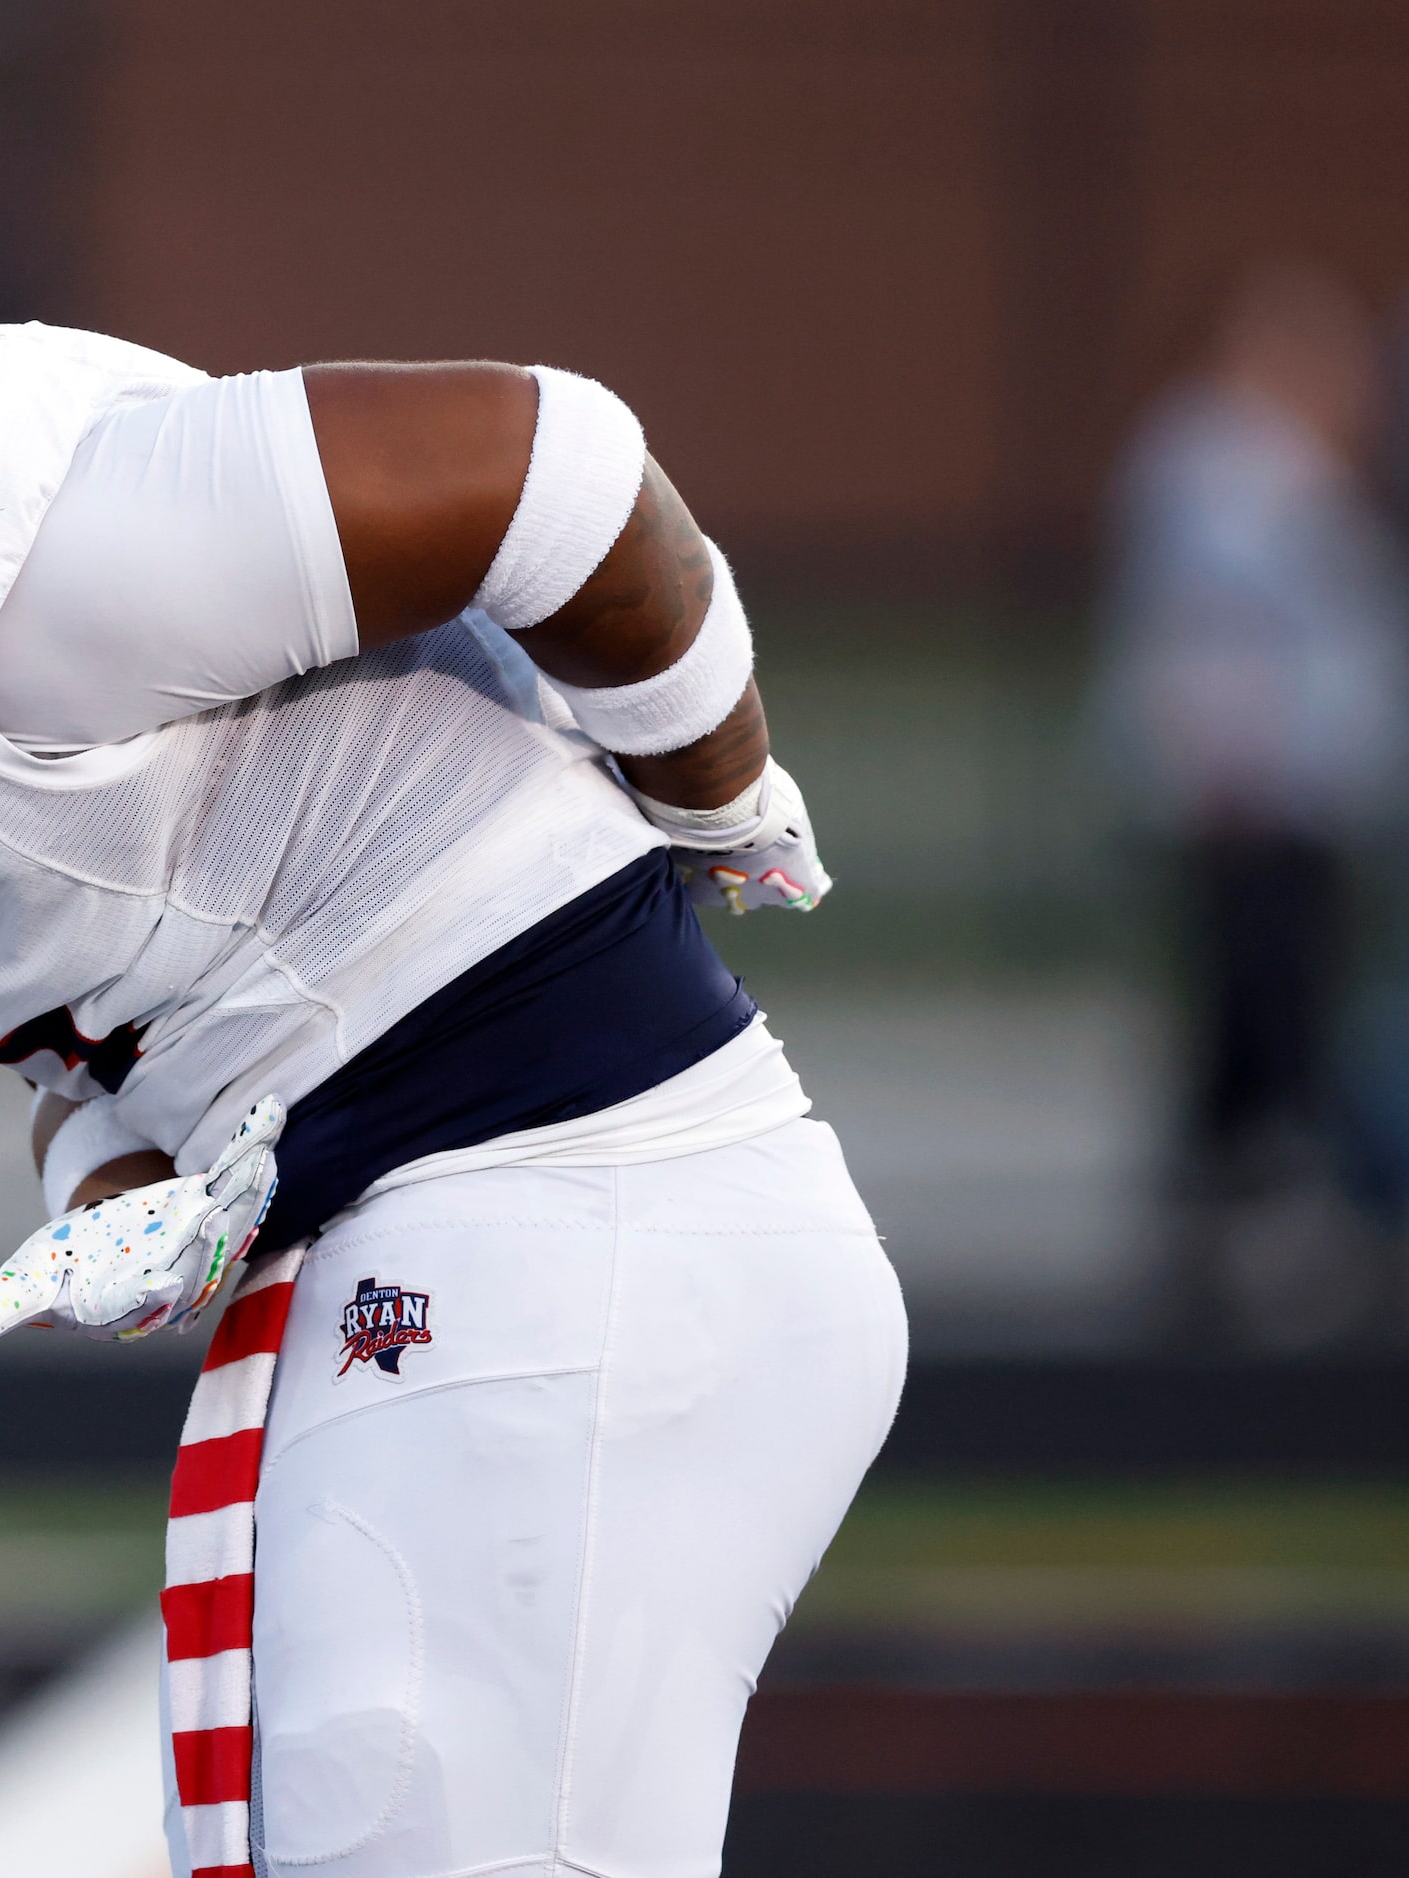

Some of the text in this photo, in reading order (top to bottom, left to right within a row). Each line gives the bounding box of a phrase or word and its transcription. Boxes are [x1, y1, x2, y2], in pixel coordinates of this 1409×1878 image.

[345, 1295, 426, 1339] RYAN
[360, 1288, 399, 1303] DENTON
[337, 1317, 433, 1377] Raiders
